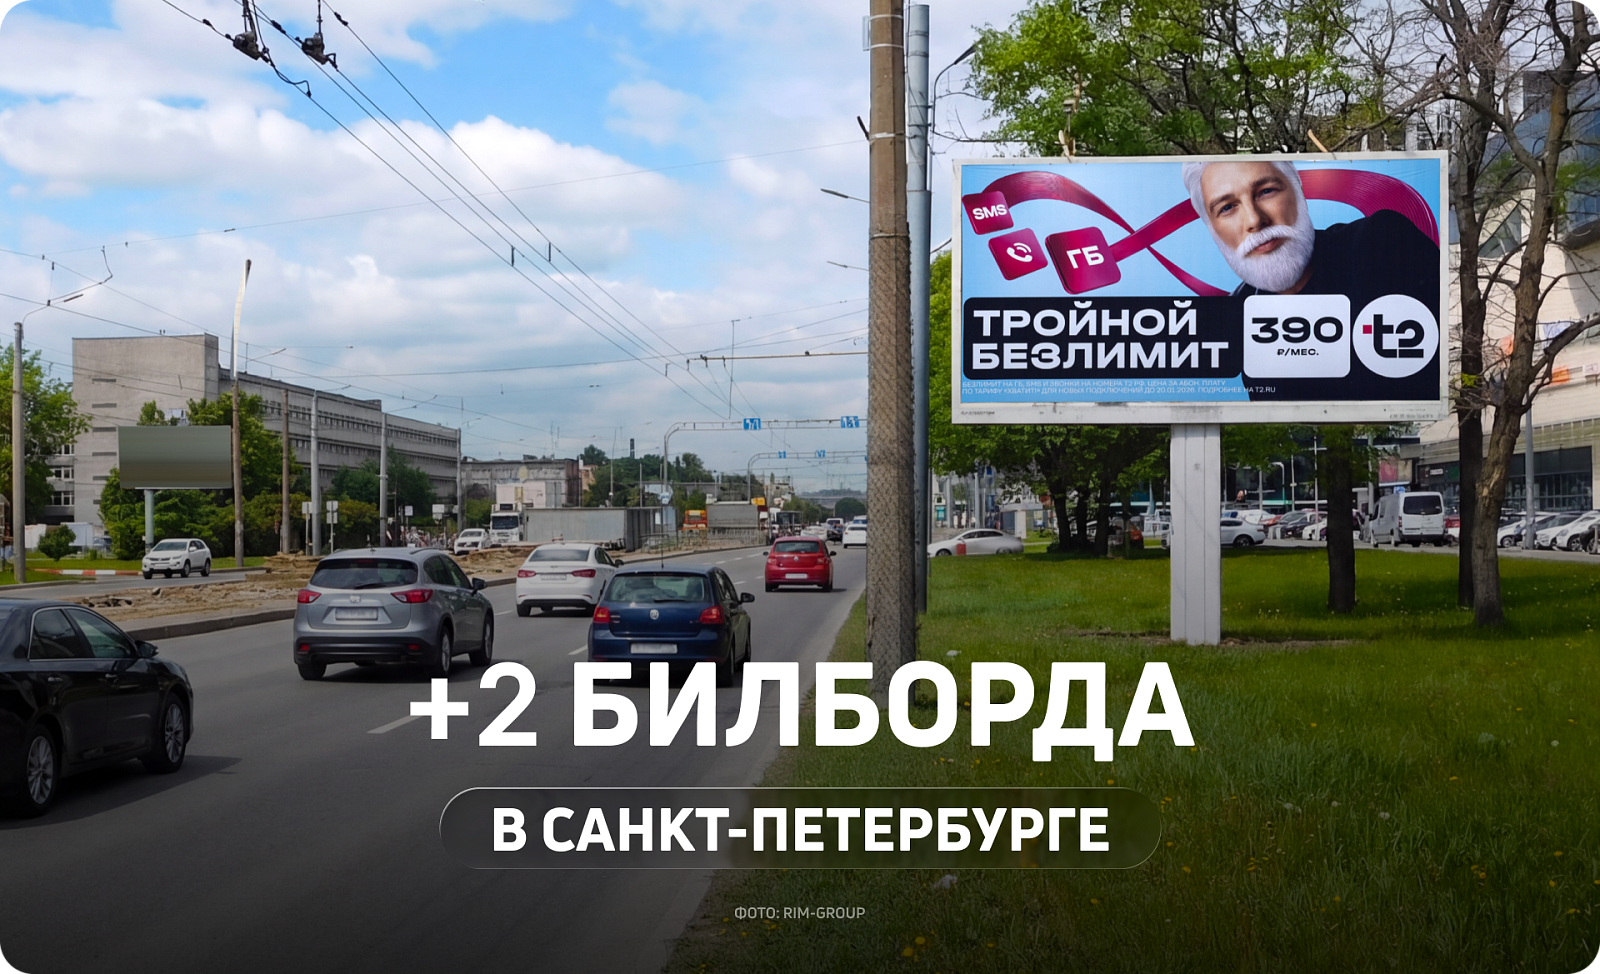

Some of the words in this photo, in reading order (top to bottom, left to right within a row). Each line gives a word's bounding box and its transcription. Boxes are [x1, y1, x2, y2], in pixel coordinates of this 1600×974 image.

[972, 204, 1008, 220] SMS
[1066, 245, 1105, 269] ГБ
[973, 300, 1197, 337] ТРОЙНОЙ
[1251, 316, 1344, 344] 390
[1363, 314, 1425, 358] t2
[972, 341, 1229, 370] БЕЗЛИМИТ
[1277, 348, 1320, 356] ₽/МЕС.
